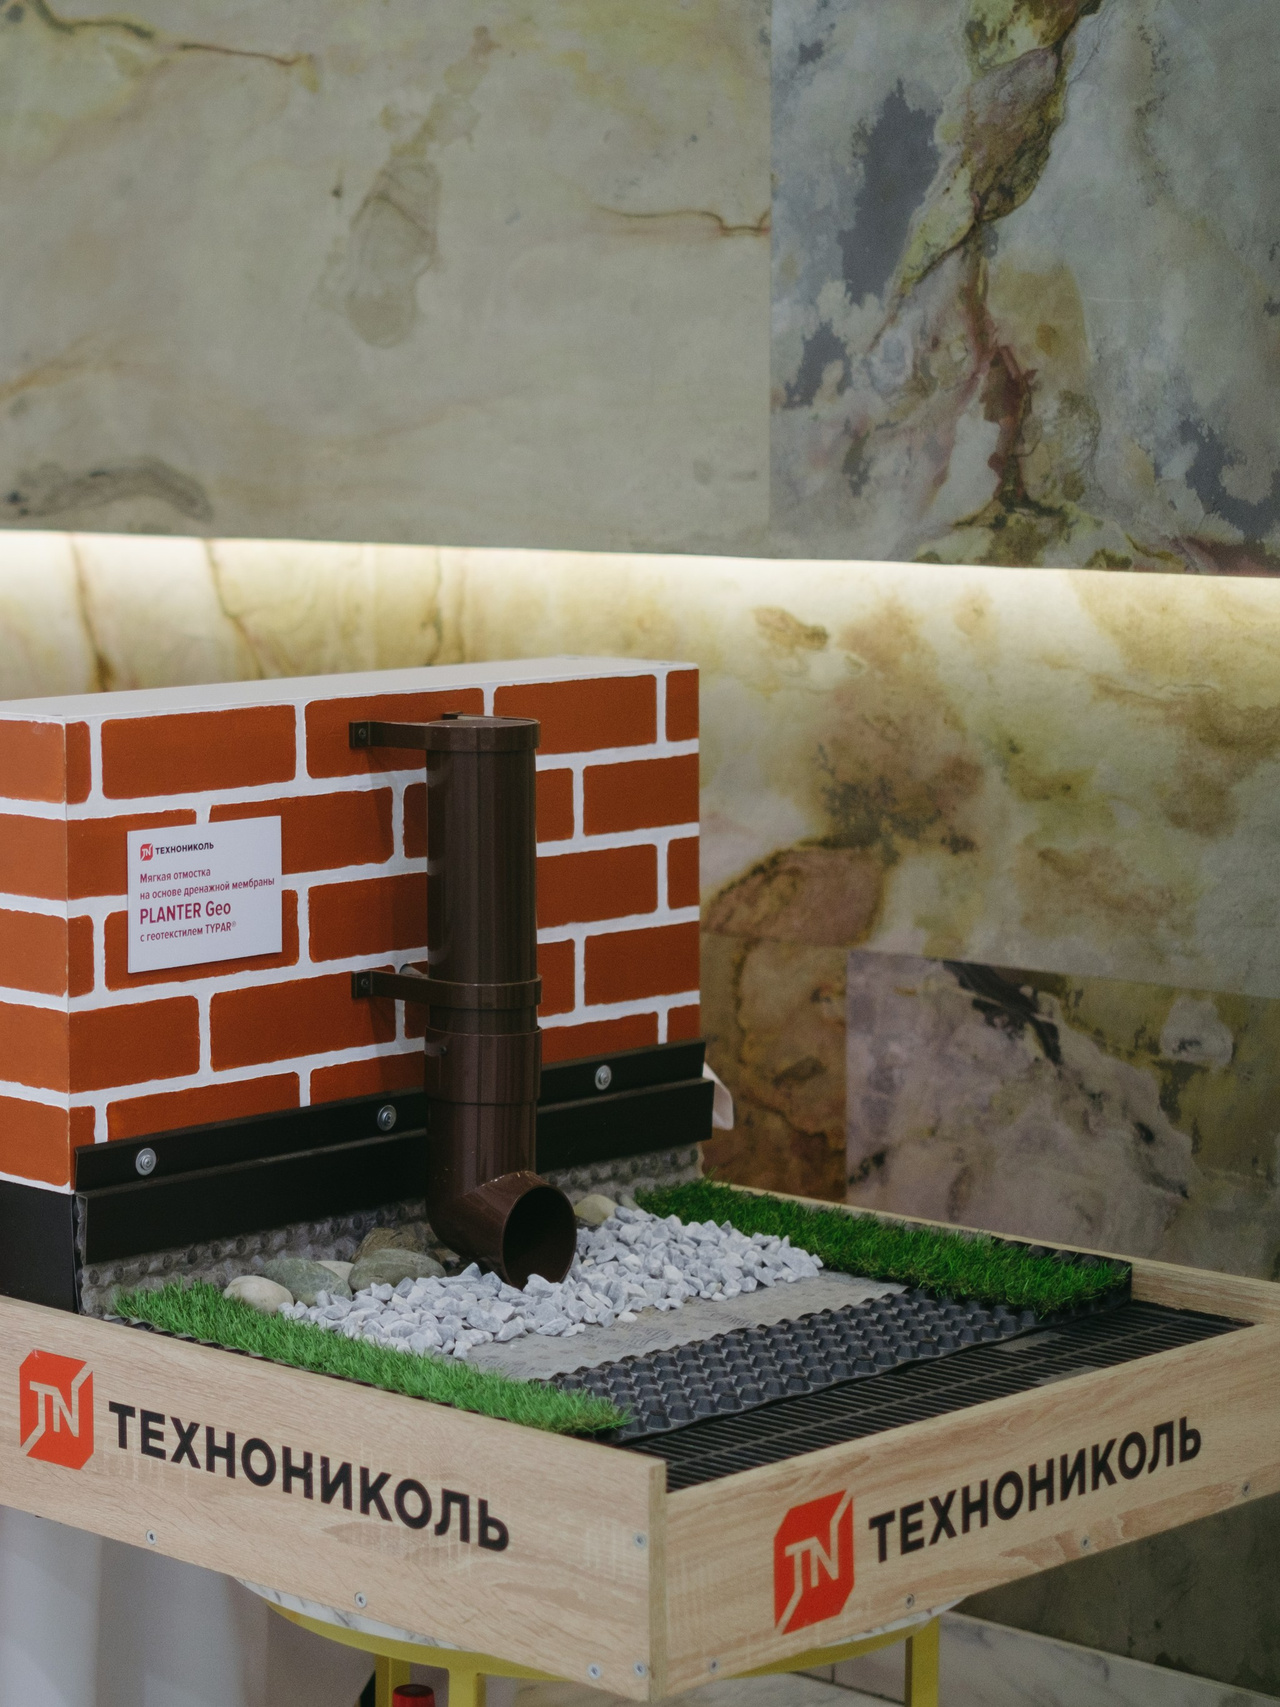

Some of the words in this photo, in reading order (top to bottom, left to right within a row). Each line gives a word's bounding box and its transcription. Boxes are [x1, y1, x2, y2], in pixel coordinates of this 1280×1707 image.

[155, 842, 214, 855] ТЕХНОНИКОЛЬ
[140, 872, 171, 884] Мягкая
[173, 868, 211, 880] отмостка
[140, 891, 150, 900] на
[152, 887, 182, 899] основе
[183, 881, 230, 898] дренажной
[231, 877, 275, 890] мембраны
[140, 902, 201, 925] PLANTER
[205, 901, 231, 917] Geo
[140, 934, 145, 942] с
[146, 927, 203, 941] геотекстилем
[109, 1401, 511, 1552] ТЕХНОНИКОЛЬ
[868, 1416, 1202, 1563] ТЕХНОНИКОЛЬ
